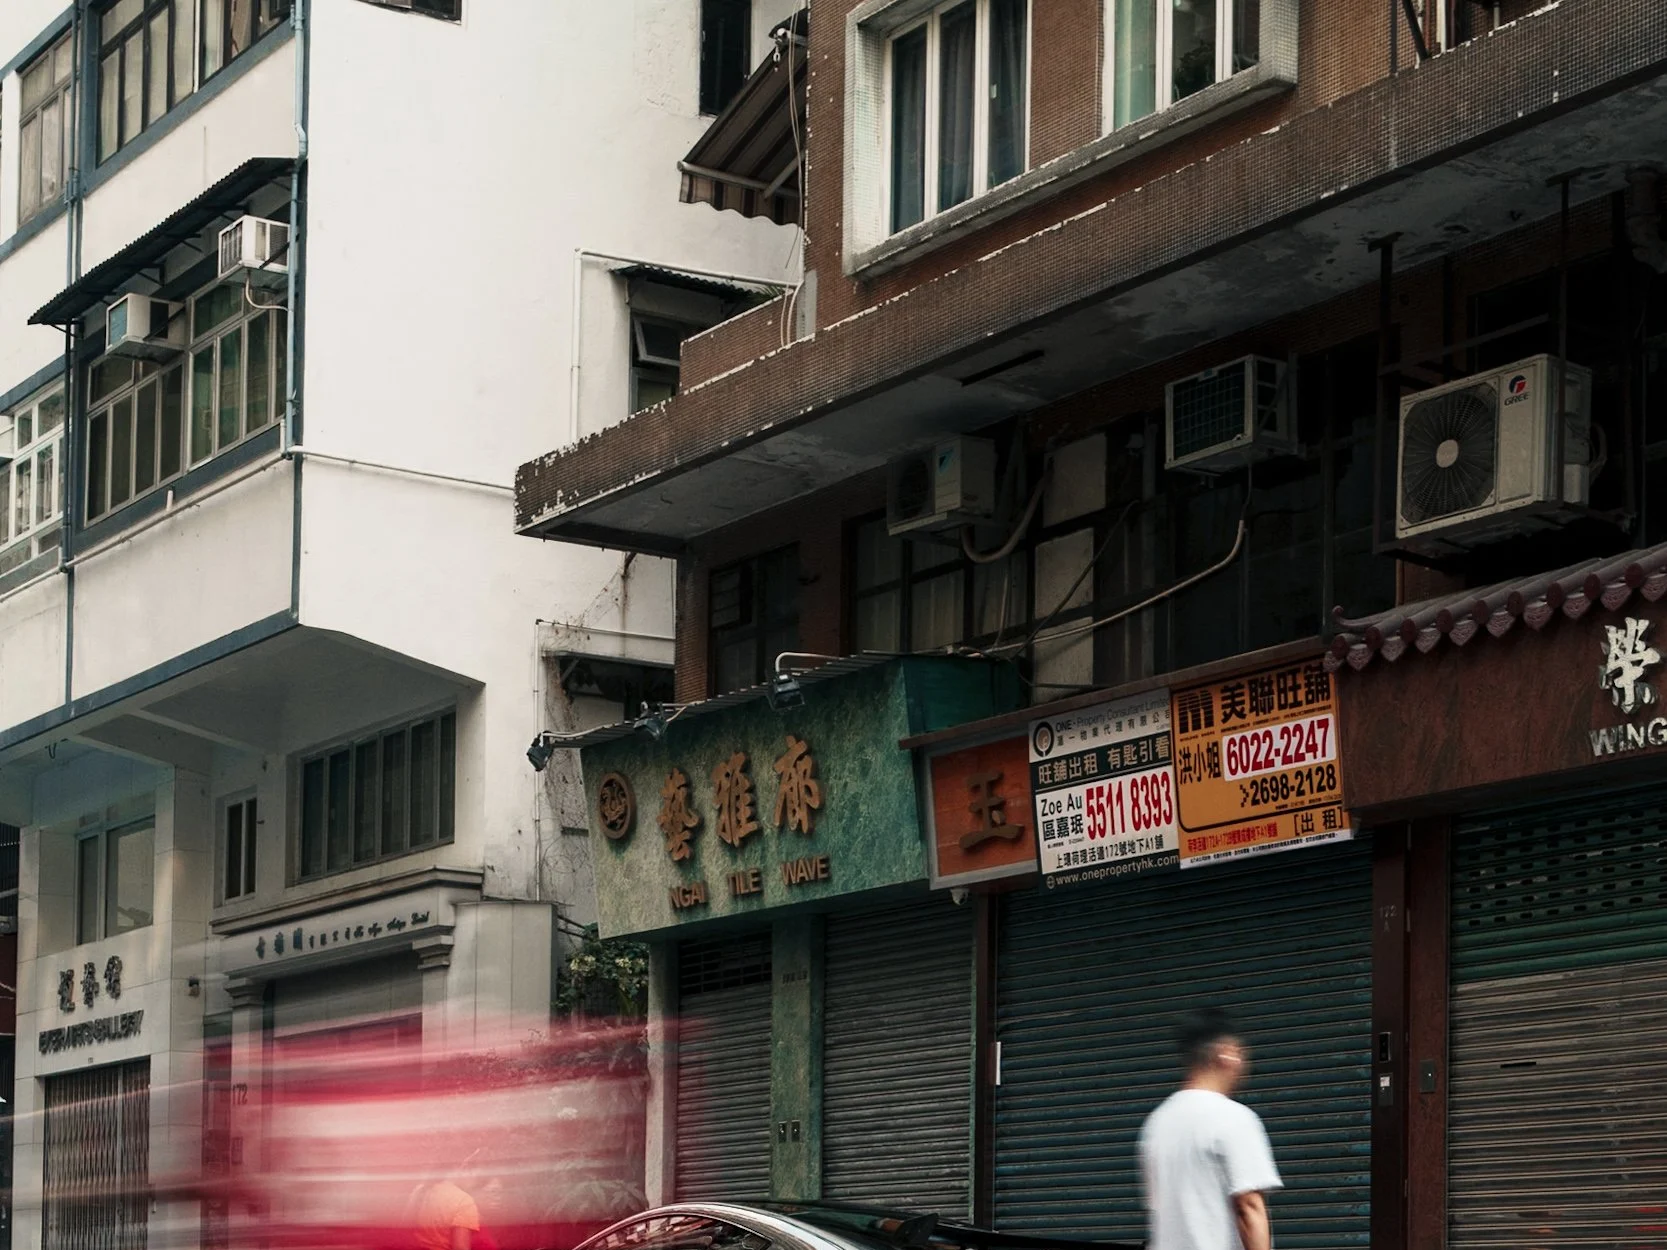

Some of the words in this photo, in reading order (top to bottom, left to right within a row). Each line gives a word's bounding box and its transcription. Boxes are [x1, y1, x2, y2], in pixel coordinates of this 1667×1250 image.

[1504, 391, 1529, 406] GREE
[1599, 616, 1661, 714] 榮
[1221, 663, 1331, 724] 美聯旺舖
[1227, 718, 1330, 776] 6022-2247
[1589, 717, 1667, 757] WING
[1038, 752, 1099, 785] 旺舖出租
[1107, 735, 1170, 771] 有匙引看
[1179, 741, 1221, 785] 洪小姐
[1041, 798, 1062, 817] Zoe
[1067, 793, 1083, 812] Au
[1086, 780, 1126, 840] 5511
[1130, 771, 1173, 831] 8393
[1250, 763, 1336, 806] 2698-2128
[670, 883, 706, 909] NGAI
[728, 869, 761, 897] TILE
[780, 856, 829, 886] WAVE
[1055, 854, 1180, 886] www.onepropertyhk.com
[232, 1083, 248, 1105] 172
